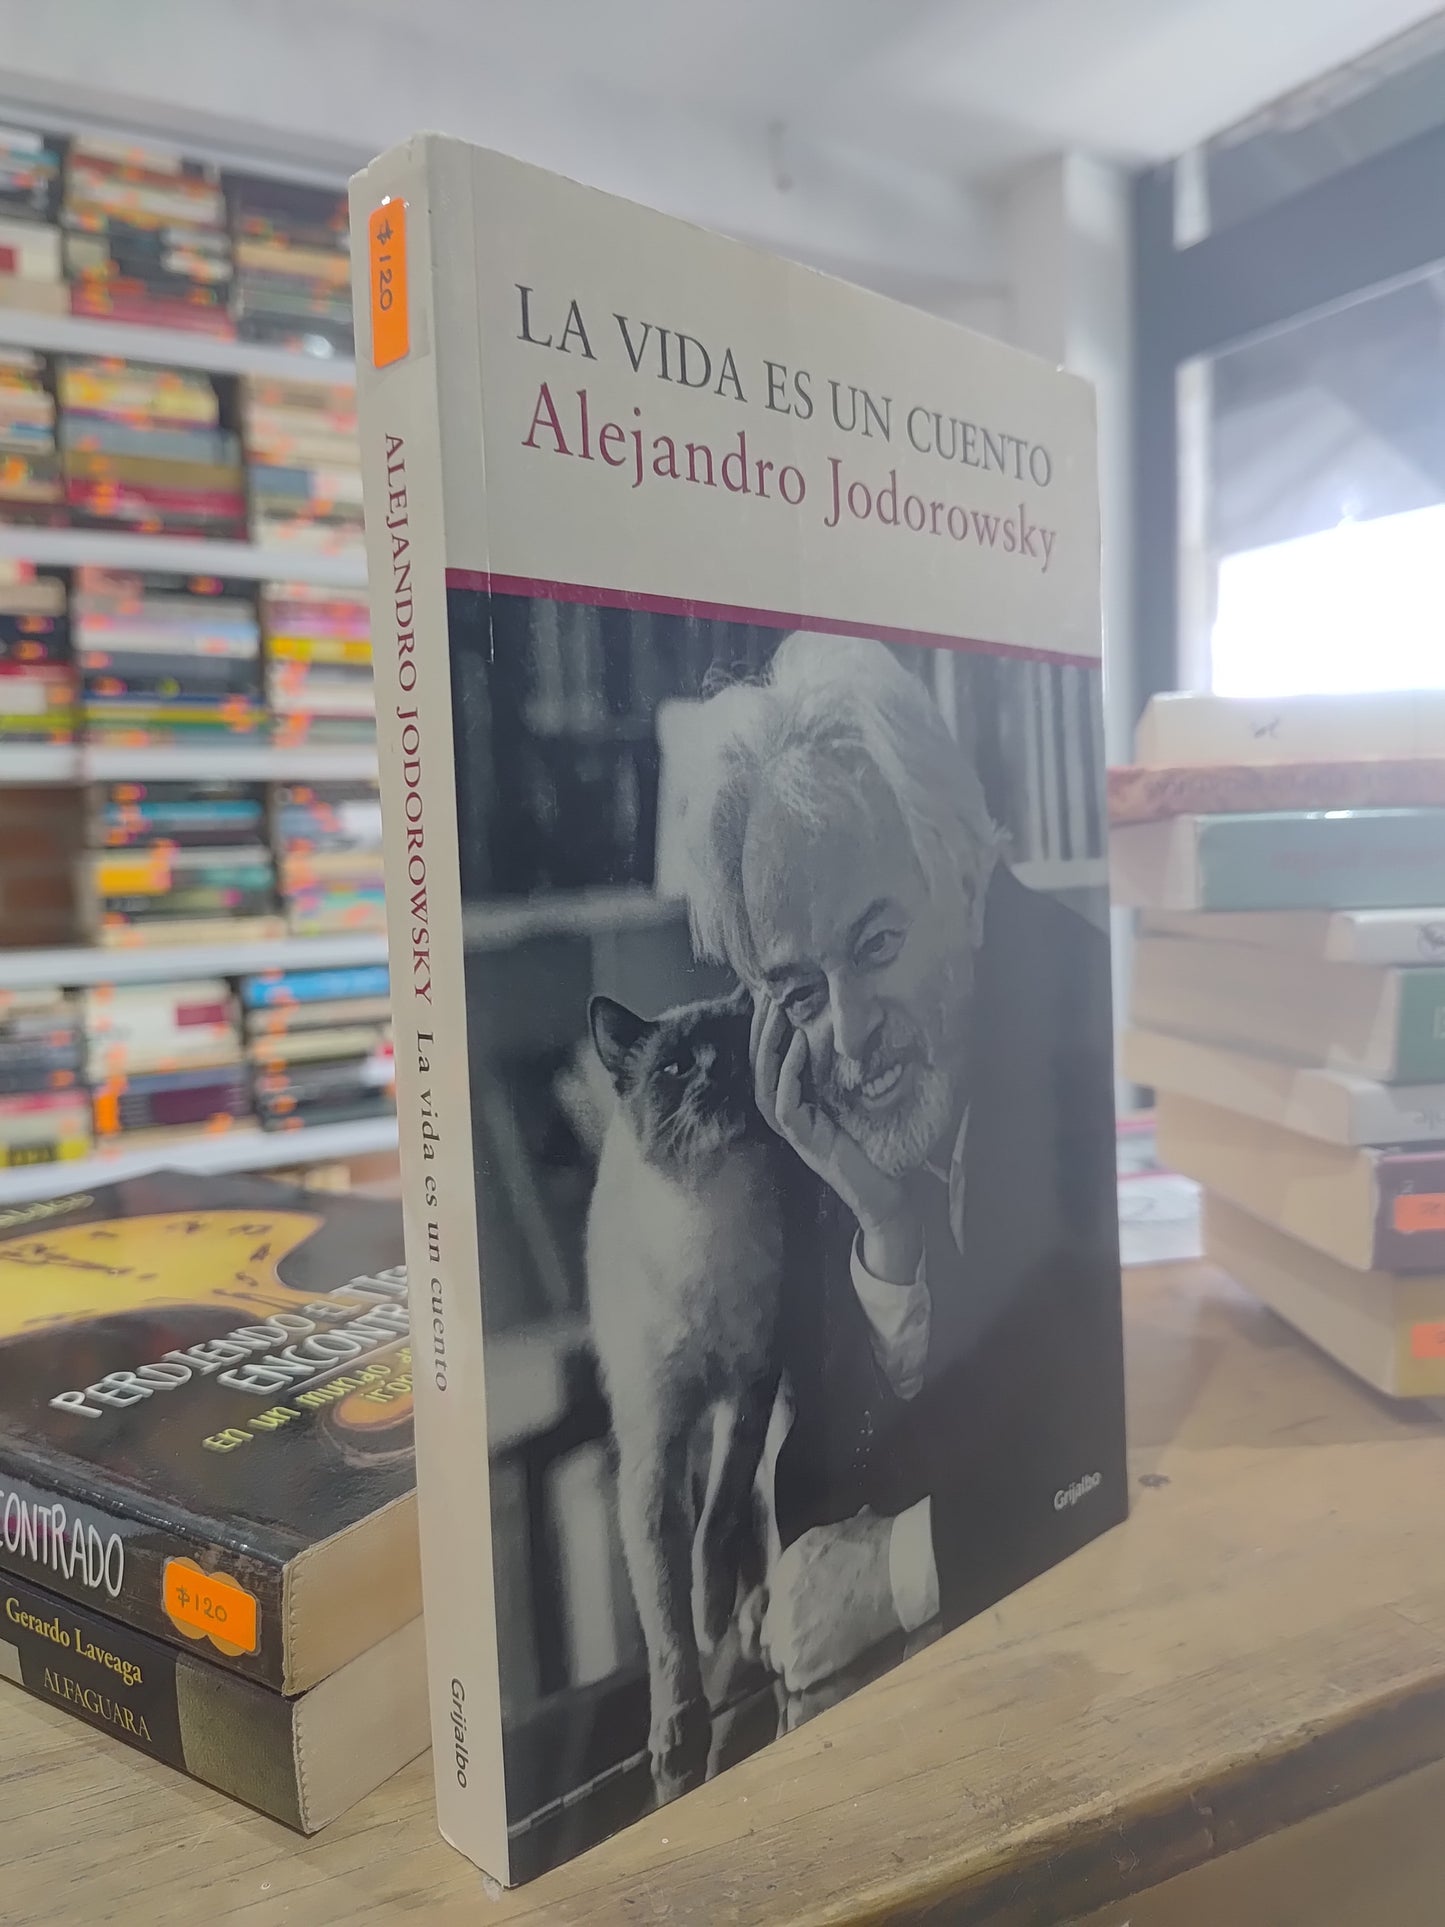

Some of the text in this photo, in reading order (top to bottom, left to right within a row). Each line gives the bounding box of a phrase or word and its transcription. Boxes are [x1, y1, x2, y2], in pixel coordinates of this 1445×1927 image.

[376, 218, 394, 312] $120
[513, 283, 1053, 488] LA VIDA ES UN CUENTO
[521, 381, 1057, 574] Alejandro Jodorowsky
[385, 432, 448, 1393] ALEJANDRO JODOROWSKY La vida es un cuento
[49, 1313, 316, 1419] PERDIENDO
[303, 1299, 361, 1323] EL
[247, 1405, 302, 1433] un
[295, 1364, 392, 1409] mundo
[1053, 1470, 1102, 1511] Grijalbo
[5, 1596, 144, 1687] Gerardo Laveaga
[175, 1584, 229, 1623] $120
[43, 1666, 152, 1742] ALFAGUARA
[450, 1677, 470, 1789] Grijalbo
